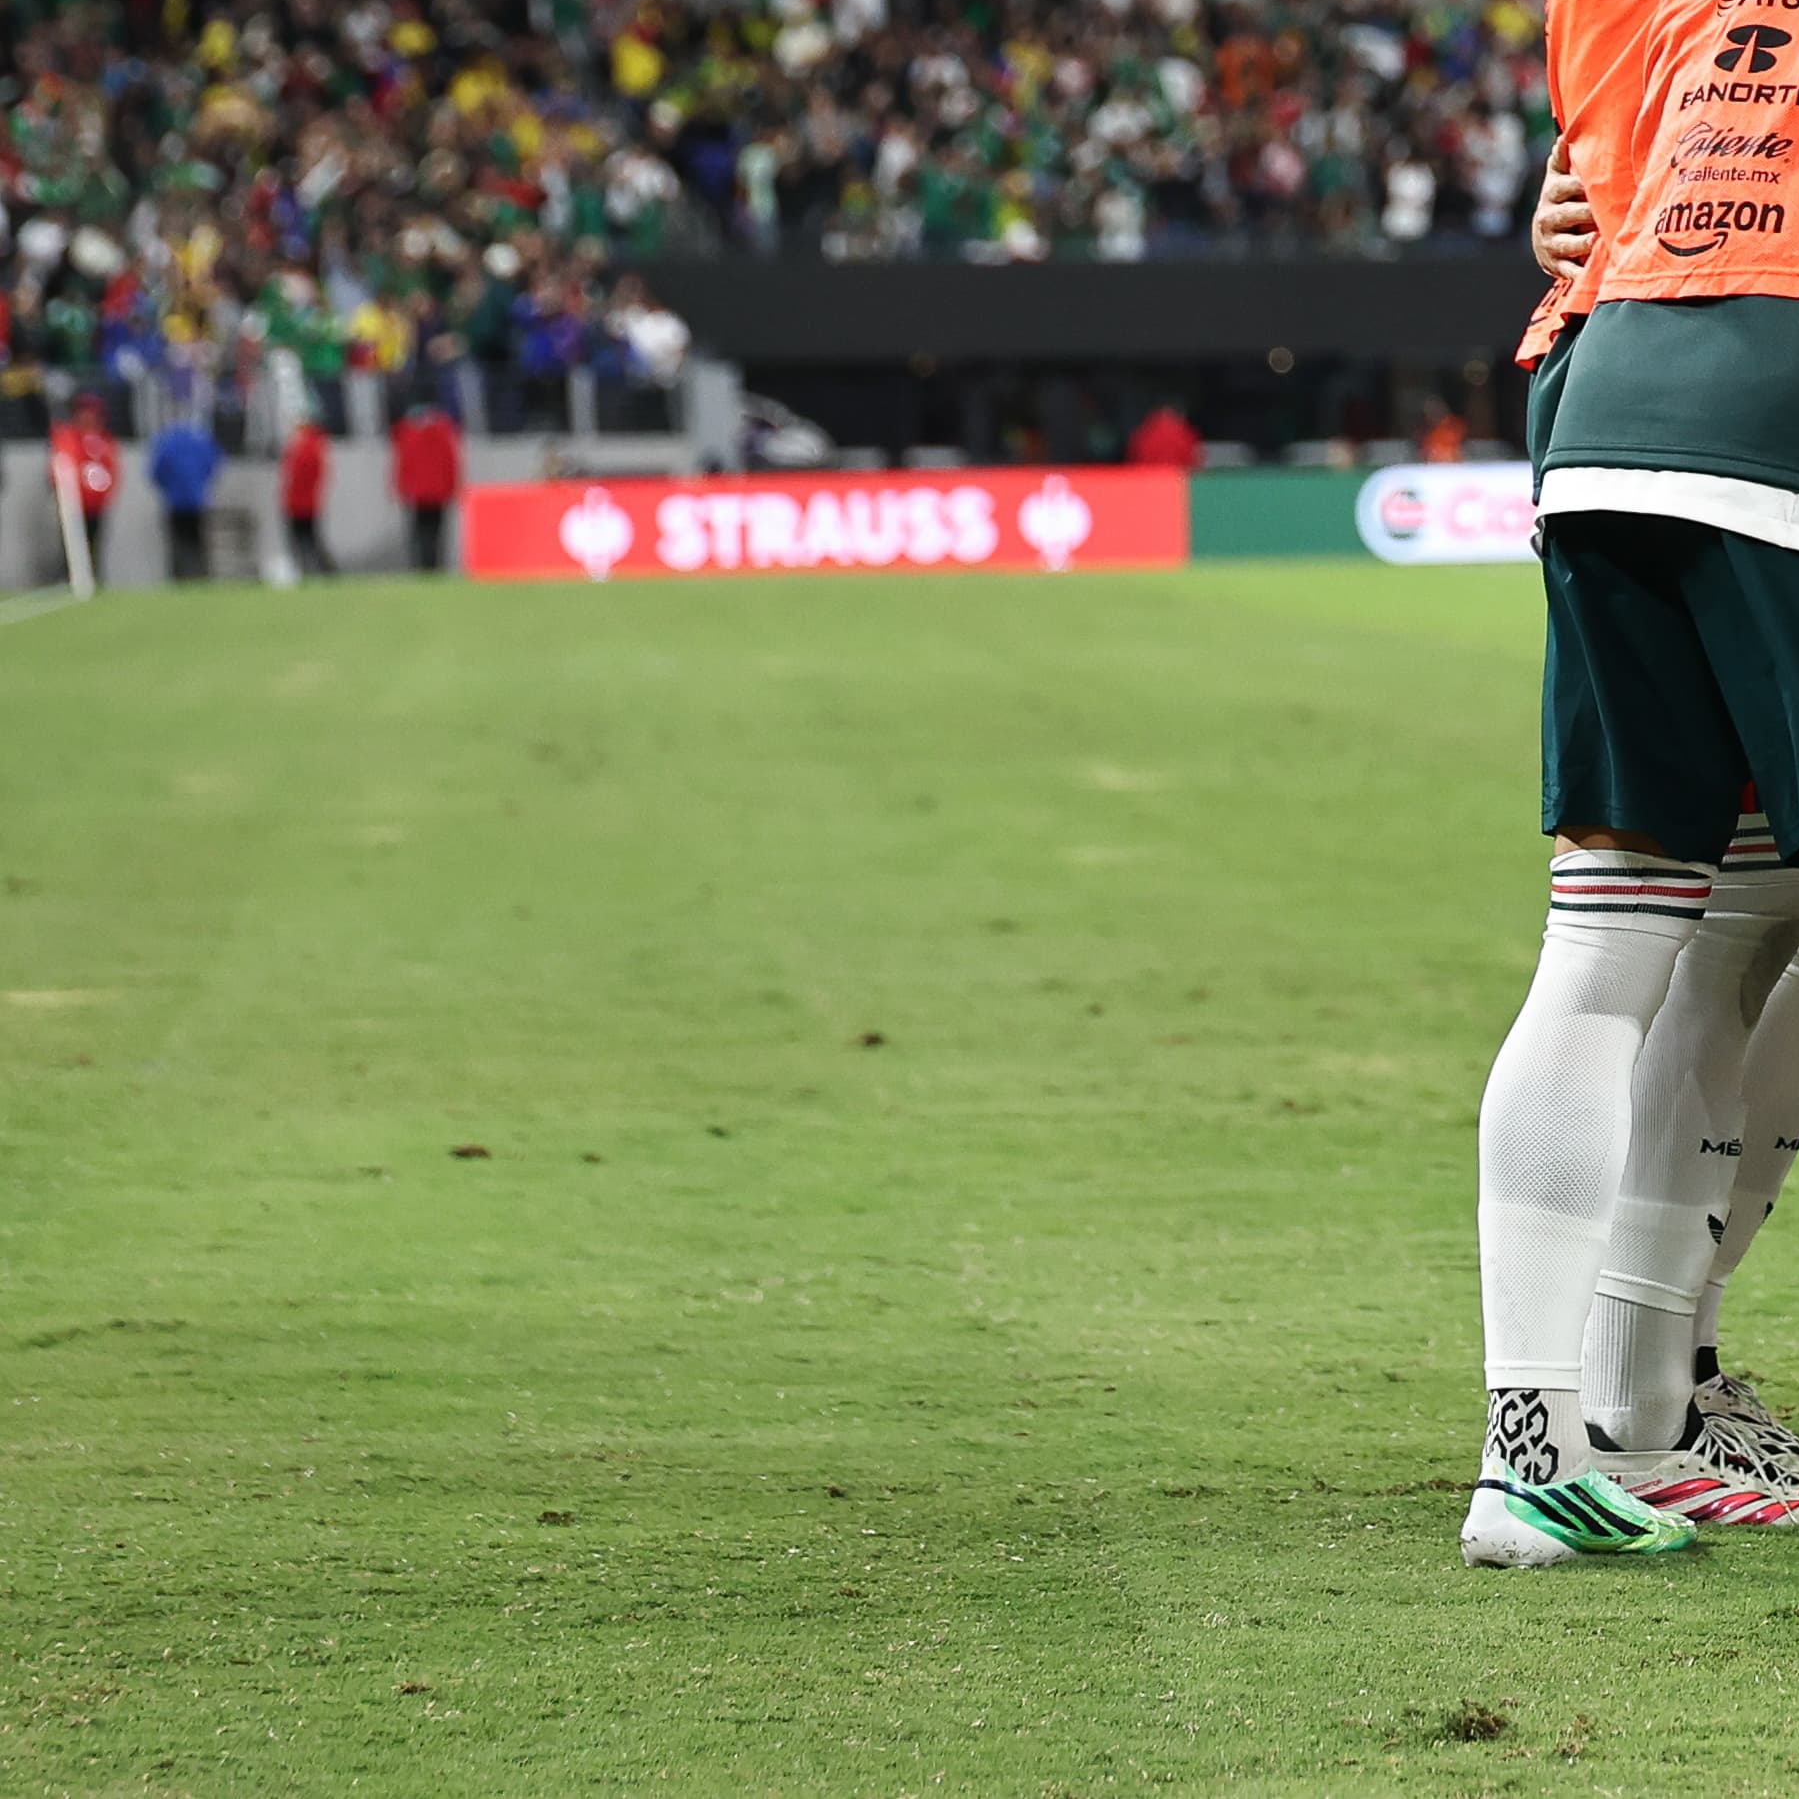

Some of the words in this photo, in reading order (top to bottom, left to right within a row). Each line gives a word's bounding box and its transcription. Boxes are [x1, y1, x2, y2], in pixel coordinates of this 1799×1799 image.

[1671, 120, 1795, 169] Caliente
[1687, 166, 1782, 185] caliente.mx
[1655, 199, 1785, 235] amazon
[654, 485, 1000, 572] STRAUSS
